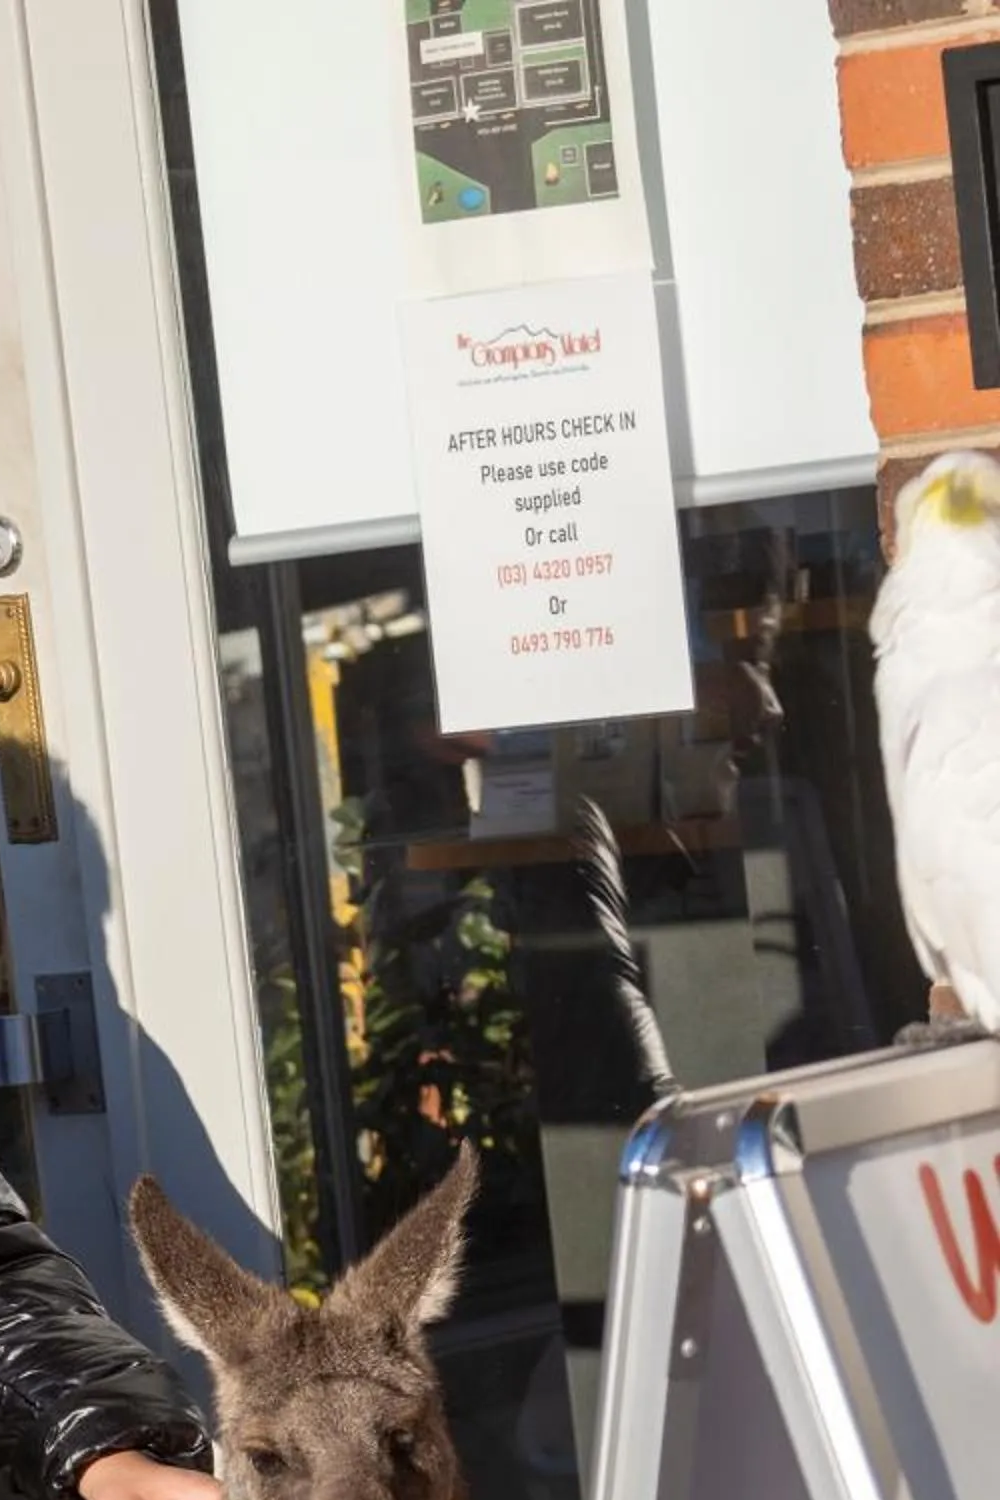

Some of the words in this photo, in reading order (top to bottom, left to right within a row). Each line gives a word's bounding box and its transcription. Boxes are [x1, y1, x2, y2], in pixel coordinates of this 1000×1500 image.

[448, 429, 497, 452] AFTER
[502, 421, 557, 446] HOURS
[561, 413, 615, 439] CHECK
[619, 410, 636, 431] IN
[480, 463, 533, 484] Please
[538, 460, 566, 477] use
[571, 451, 609, 473] code
[514, 485, 581, 515] supplied
[525, 527, 543, 546] Or
[549, 522, 579, 543] call
[497, 563, 527, 588] (03)
[533, 559, 571, 580] 4320
[575, 553, 613, 576] 0957
[549, 595, 567, 615] Or
[511, 633, 549, 655] 0493
[553, 628, 581, 651] 790
[585, 626, 614, 647] 776
